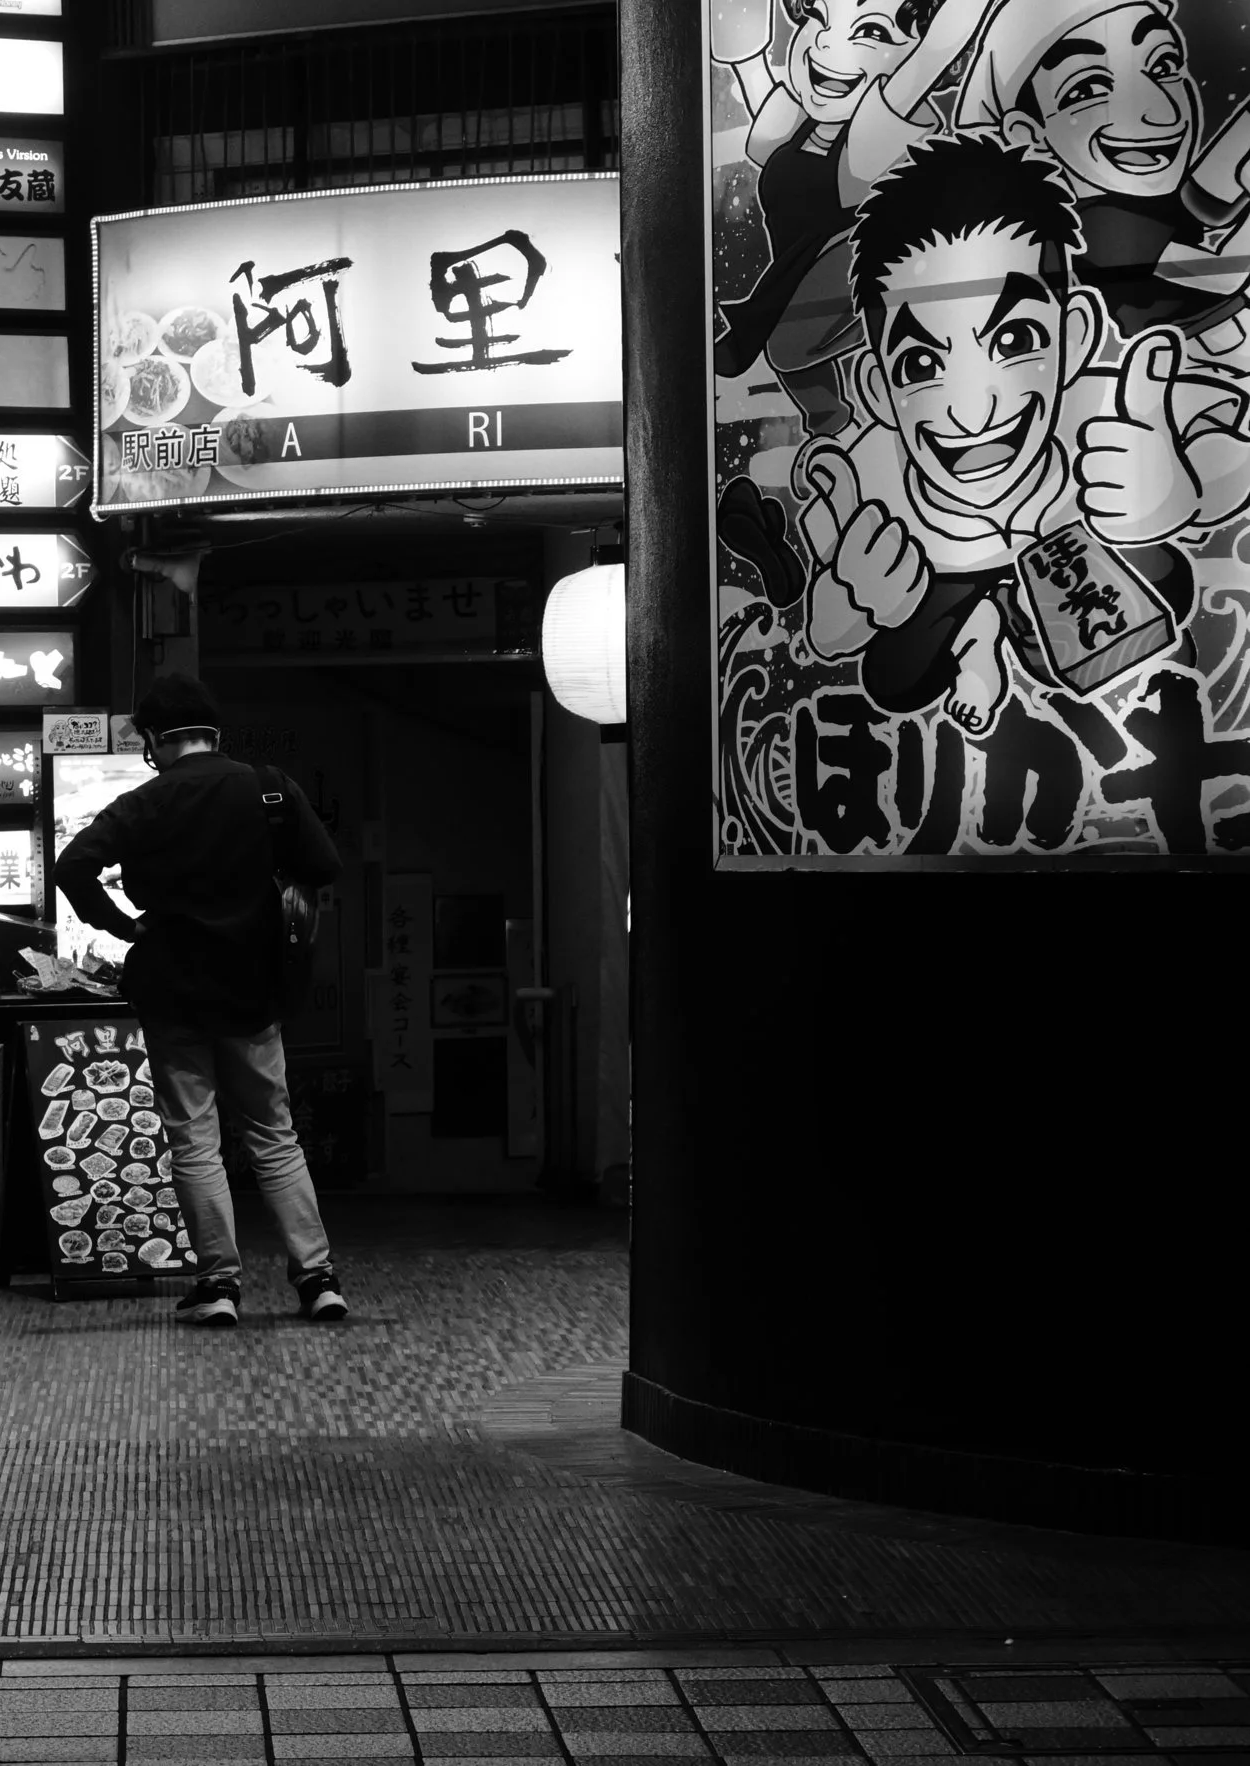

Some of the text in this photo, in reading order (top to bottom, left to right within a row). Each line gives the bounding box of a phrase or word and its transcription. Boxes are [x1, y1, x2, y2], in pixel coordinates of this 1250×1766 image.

[6, 148, 49, 162] Virsion
[280, 411, 504, 458] A RI
[121, 425, 222, 471] 駅前店
[58, 464, 90, 481] 2F
[60, 562, 91, 579] 2F
